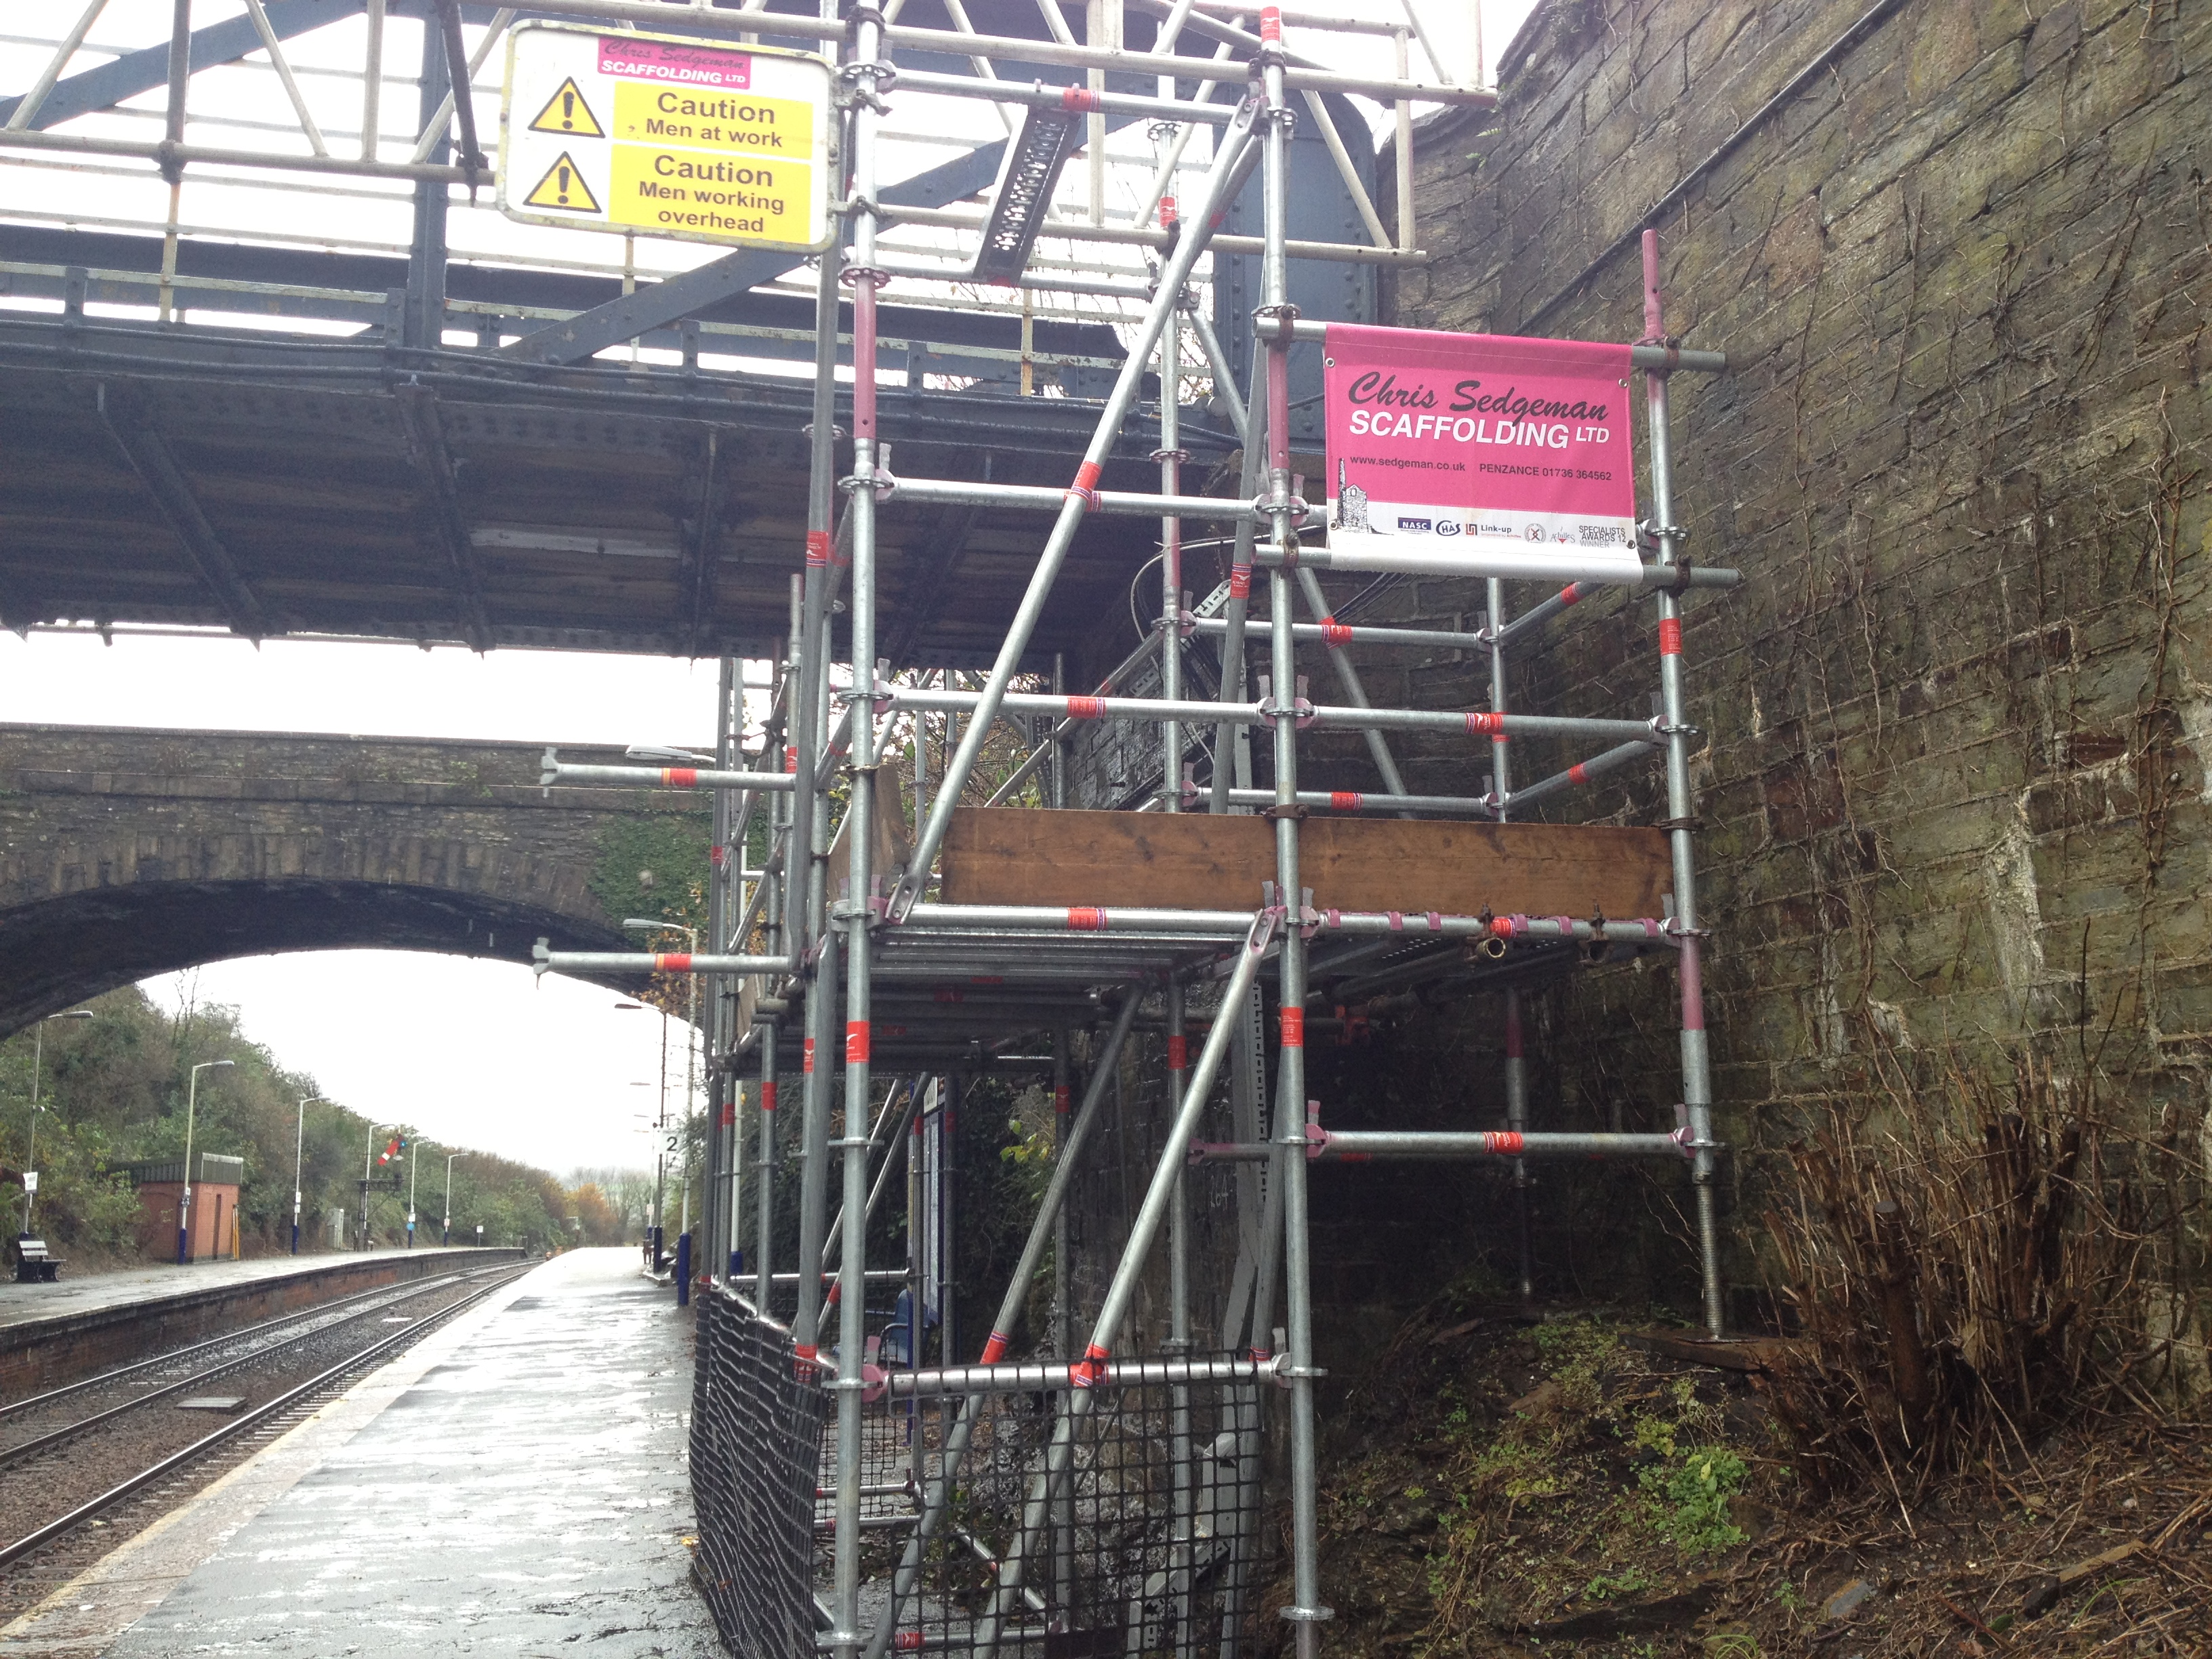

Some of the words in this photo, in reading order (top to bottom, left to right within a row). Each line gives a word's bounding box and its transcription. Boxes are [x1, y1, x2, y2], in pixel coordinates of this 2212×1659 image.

[605, 41, 652, 59] Chris
[602, 60, 722, 83] SCAFFOLDING
[726, 74, 746, 83] LTD
[657, 92, 775, 124] Caution
[646, 118, 693, 138] Men
[700, 123, 722, 140] at
[728, 127, 783, 148] work
[654, 155, 773, 187] Caution
[639, 181, 686, 201] Men
[693, 189, 784, 215] working
[658, 209, 764, 233] overhead
[1348, 371, 1438, 409] Chris
[1449, 380, 1609, 426] Sedgeman
[1349, 410, 1570, 449] SCAFFOLDING
[1576, 426, 1610, 444] LTD
[1350, 456, 1466, 472] www.sedgeman.co.uk
[1479, 464, 1539, 476] PENZANCE
[1542, 468, 1574, 478] 01736
[1576, 470, 1612, 480] 364562
[1402, 521, 1428, 530] NASC
[1481, 525, 1512, 534] Link-up
[1579, 525, 1626, 535] SPECIALISTS
[1580, 539, 1610, 548] WINNER
[1581, 533, 1616, 542] AWARDS
[1618, 535, 1626, 543] 12
[666, 1136, 678, 1151] 2
